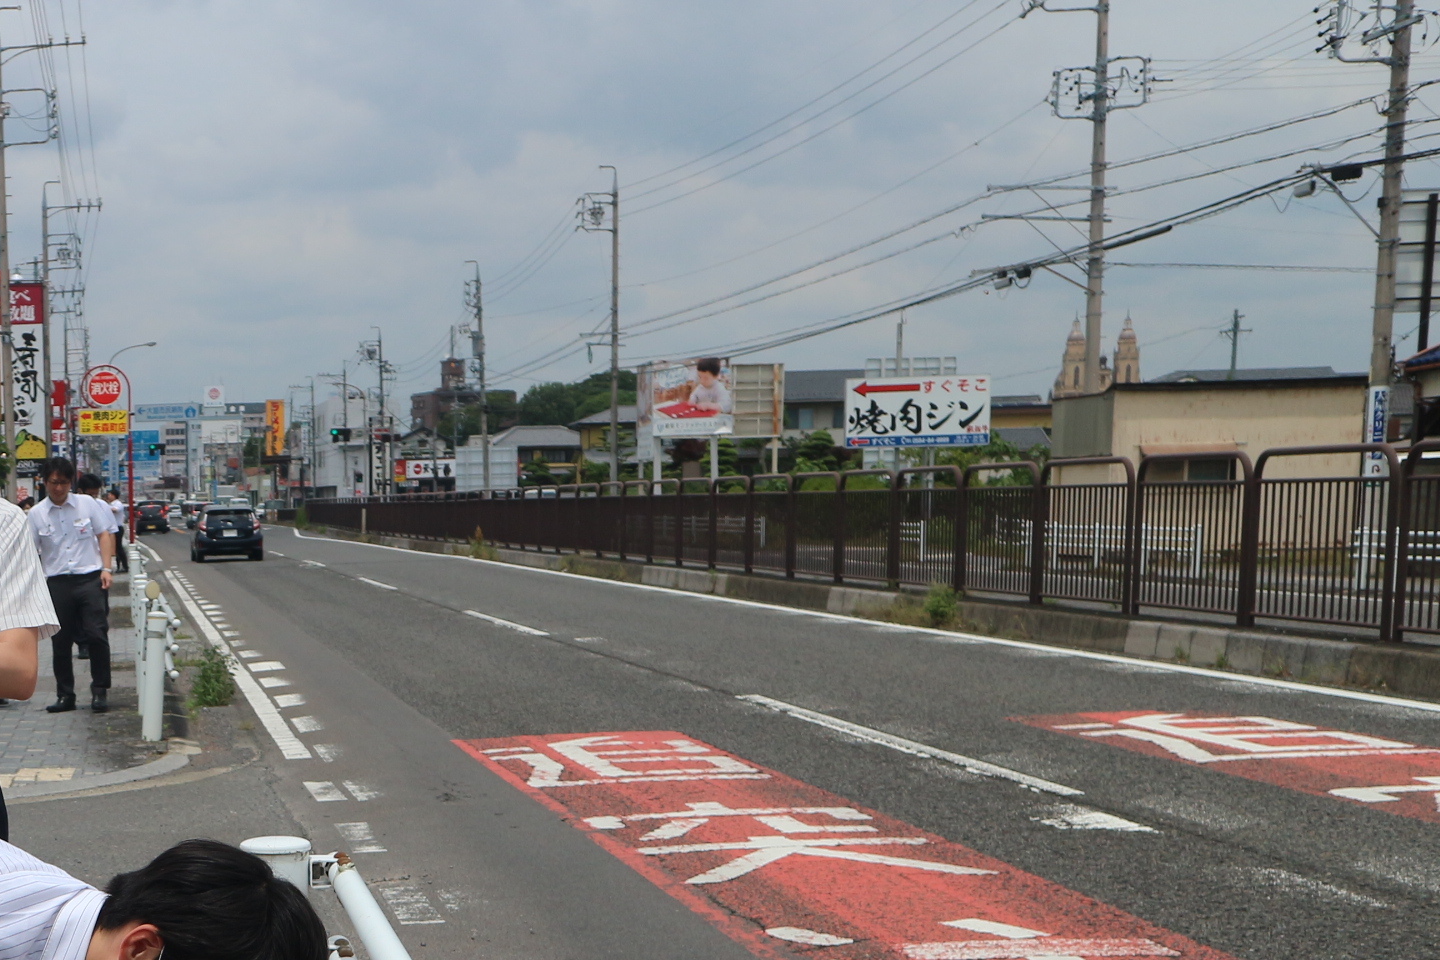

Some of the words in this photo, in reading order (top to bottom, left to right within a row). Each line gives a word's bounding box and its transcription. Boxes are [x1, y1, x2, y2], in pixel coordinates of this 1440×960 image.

[91, 381, 119, 395] 消火栓
[922, 379, 987, 393] すぐそこ
[93, 411, 126, 420] 焼肉ジン
[848, 398, 985, 434] 焼肉ジン
